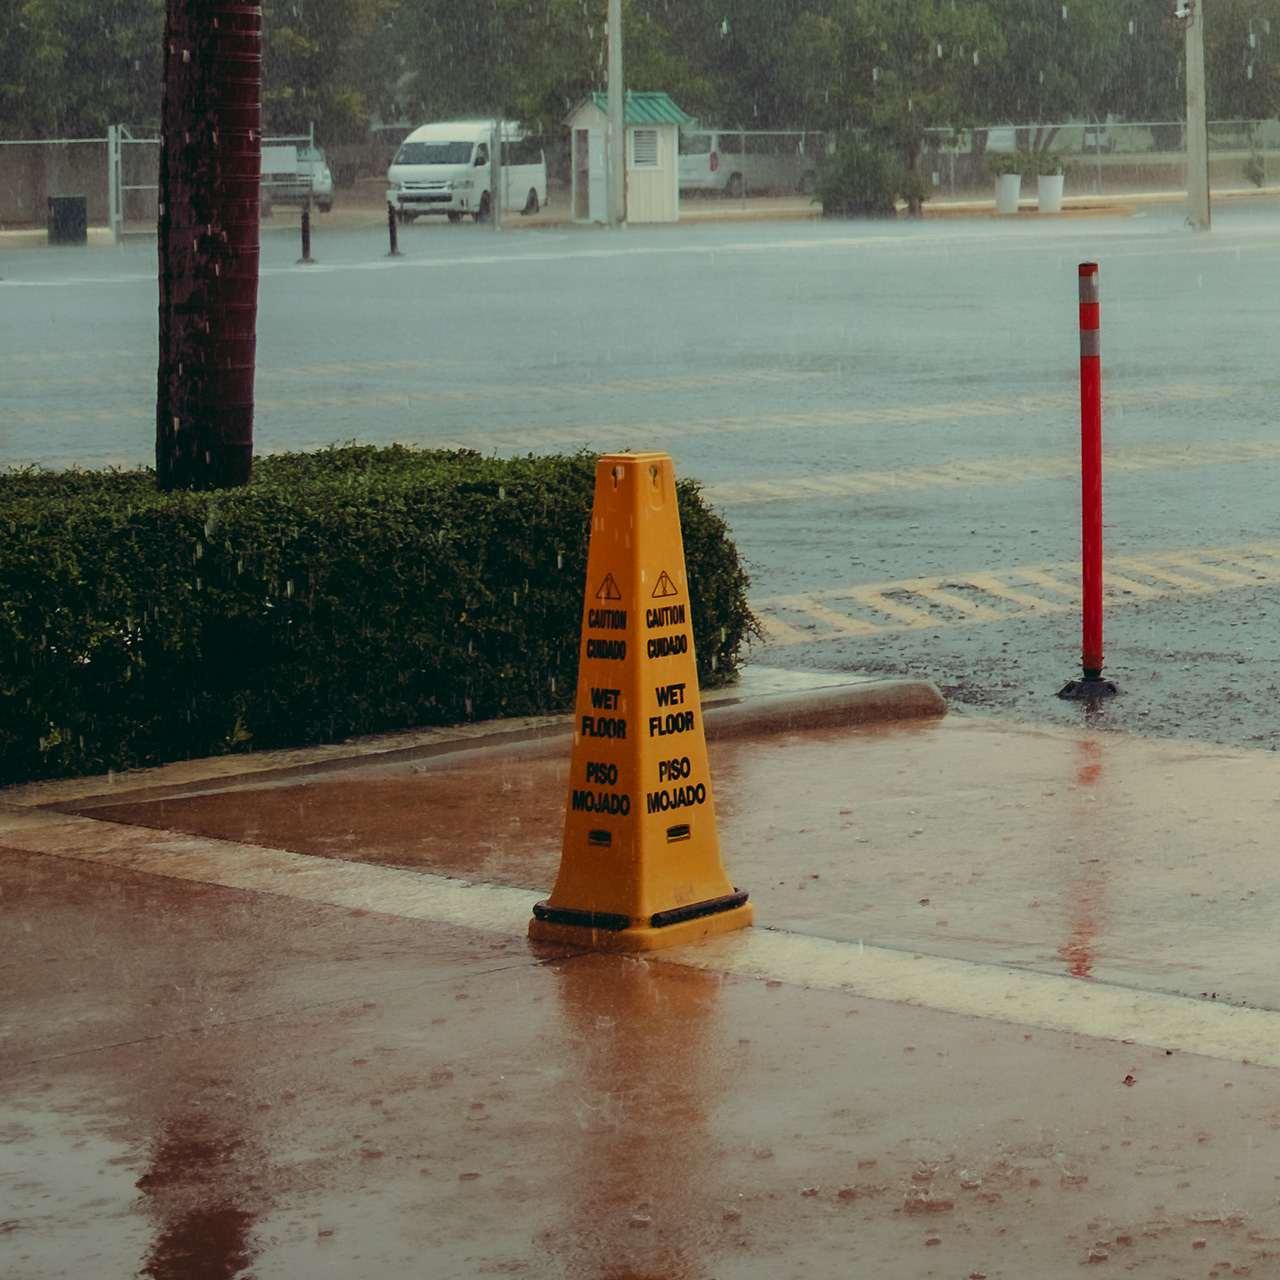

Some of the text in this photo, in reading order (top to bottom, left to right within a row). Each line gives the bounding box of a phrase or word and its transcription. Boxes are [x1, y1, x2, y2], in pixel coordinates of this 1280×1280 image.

[588, 608, 627, 630] CAUTION
[646, 604, 685, 629] CAUTION
[587, 638, 626, 660] CUIDADO
[647, 634, 687, 659] CUIDADO
[591, 687, 621, 710] WET
[655, 683, 686, 707] WET
[582, 715, 627, 739] FLOOR
[649, 710, 695, 737] FLOOR
[586, 761, 618, 786] PISO
[659, 757, 691, 783] PISO
[572, 790, 630, 816] MOJADO
[646, 783, 706, 814] MOJADO
